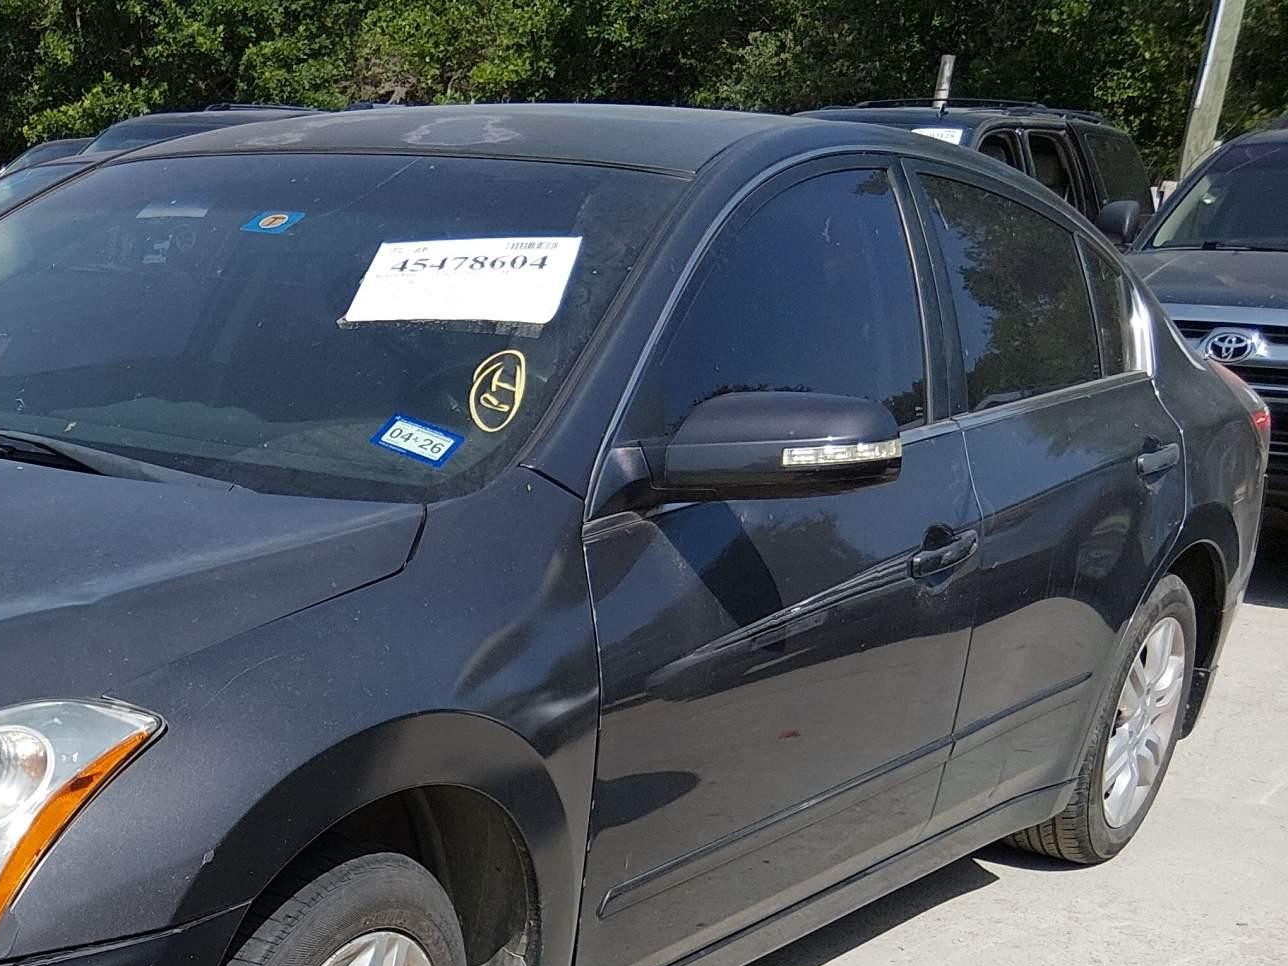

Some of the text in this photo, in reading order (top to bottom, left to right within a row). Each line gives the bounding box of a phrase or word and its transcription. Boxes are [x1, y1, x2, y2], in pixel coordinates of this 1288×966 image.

[390, 255, 548, 272] 45478604
[389, 428, 414, 443] 04
[418, 438, 445, 454] 26
